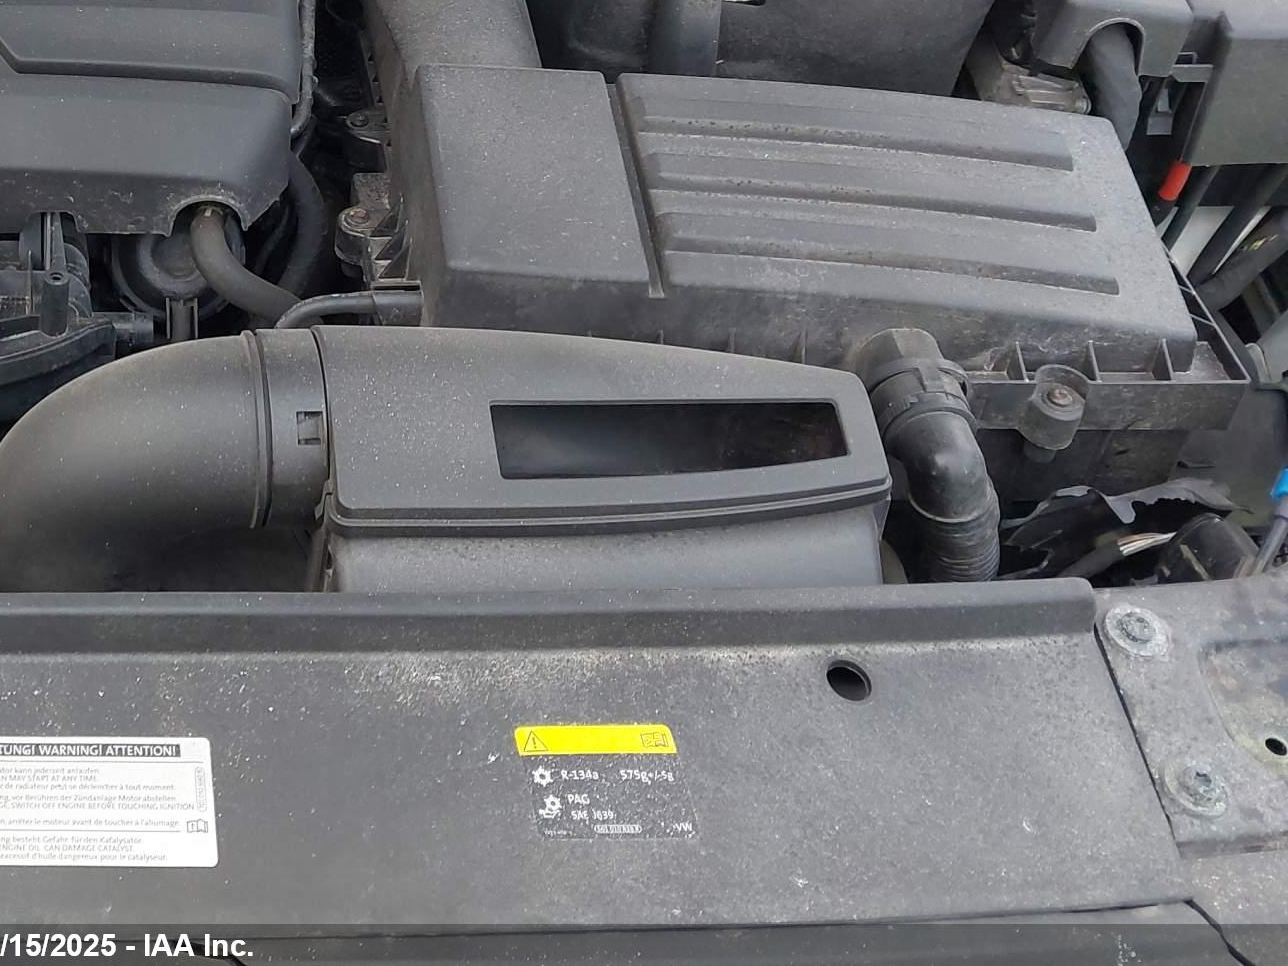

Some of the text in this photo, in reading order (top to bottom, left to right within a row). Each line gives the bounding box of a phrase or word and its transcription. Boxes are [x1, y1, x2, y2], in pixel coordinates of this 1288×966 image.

[39, 745, 102, 755] WARNING!
[105, 745, 176, 756] ATTENTION!
[561, 769, 599, 780] R-134a
[5, 782, 14, 790] de
[18, 782, 48, 790] radiateur
[125, 782, 141, 790] tout
[60, 794, 72, 802] der
[118, 795, 142, 803] Motor
[567, 793, 590, 804] PAG
[11, 802, 40, 810] SWITCH
[42, 802, 56, 810] OFF
[58, 802, 85, 810] ENGINE
[88, 802, 116, 810] BEFORE
[570, 810, 589, 820] SAE
[100, 853, 117, 862] pour
